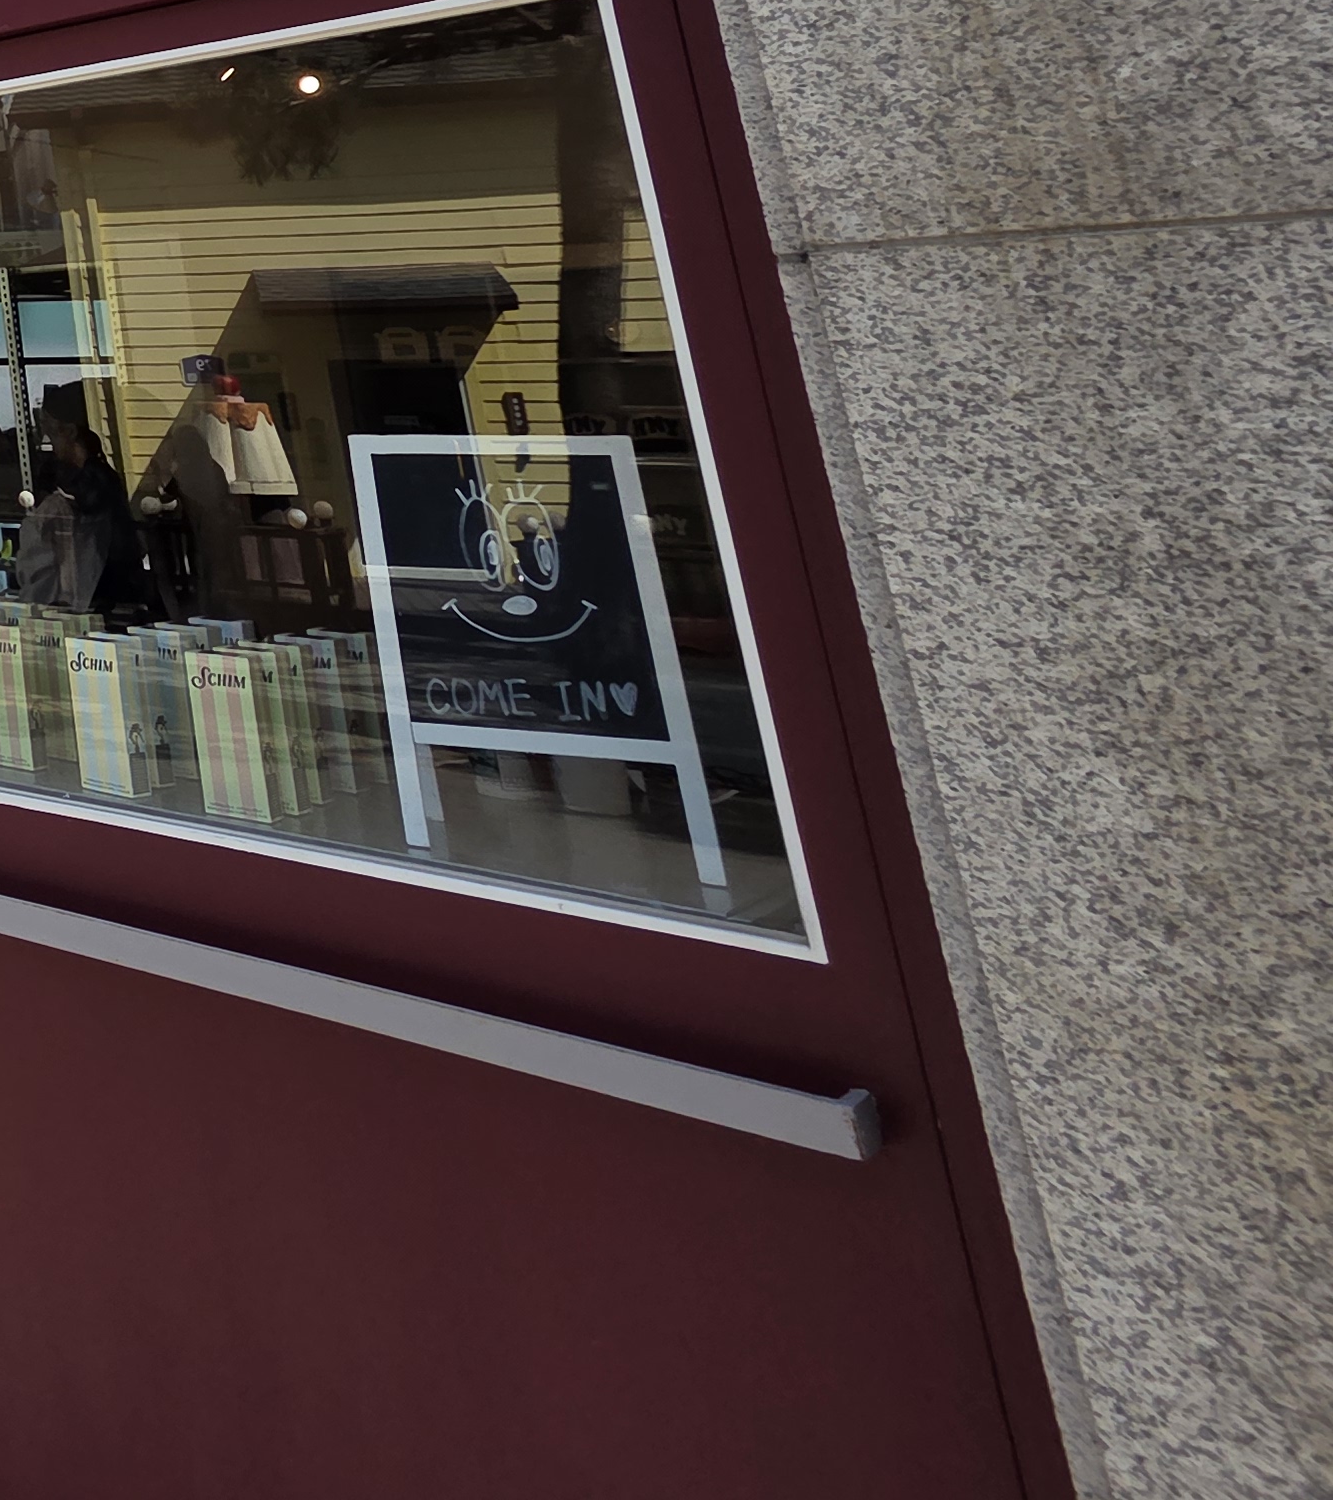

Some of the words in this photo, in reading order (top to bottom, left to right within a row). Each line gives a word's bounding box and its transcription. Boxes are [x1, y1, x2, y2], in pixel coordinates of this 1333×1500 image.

[70, 651, 113, 673] SCHIM
[191, 665, 247, 689] SCHIM
[426, 677, 537, 717] COME
[553, 680, 609, 721] IN
